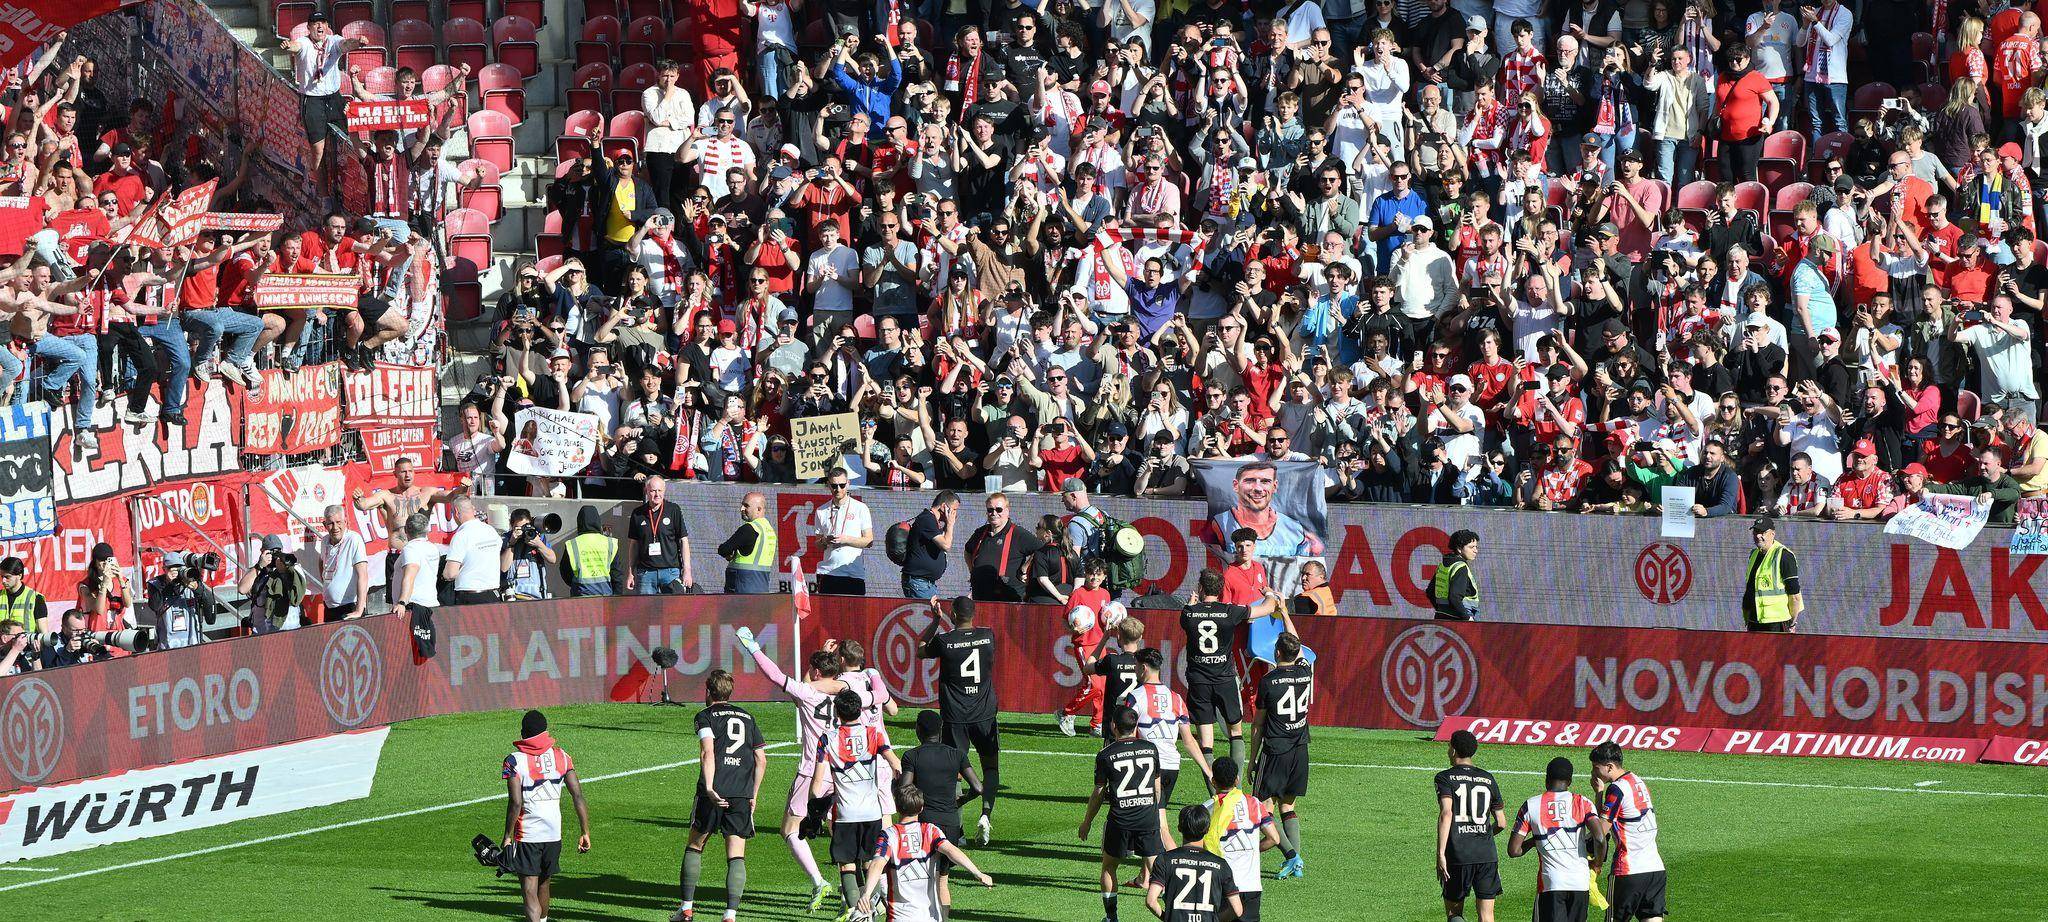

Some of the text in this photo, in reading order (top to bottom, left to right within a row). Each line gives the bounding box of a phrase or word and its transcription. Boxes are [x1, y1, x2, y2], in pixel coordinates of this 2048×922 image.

[406, 113, 427, 122] UNS
[260, 293, 296, 304] IMMER
[344, 368, 434, 417] COLEGIO
[247, 411, 280, 449] RED
[798, 446, 829, 459] Trikot
[450, 623, 778, 686] PLATINUM
[1197, 620, 1219, 654] 8
[960, 648, 981, 684] 4
[128, 667, 261, 740] ETORO
[964, 685, 979, 695] TAH
[1276, 682, 1311, 722] 44
[1573, 655, 1762, 717] NOVO
[725, 717, 746, 755] 9
[1466, 718, 1681, 750] CATS & DOGS
[1723, 730, 1967, 762] PLATINUM.com
[723, 756, 742, 767] KANE
[1113, 757, 1155, 799] 22
[22, 765, 261, 847] WÜRTH
[1454, 783, 1491, 825] 10
[1179, 858, 1198, 867] BAYERN
[1173, 867, 1215, 912] 21
